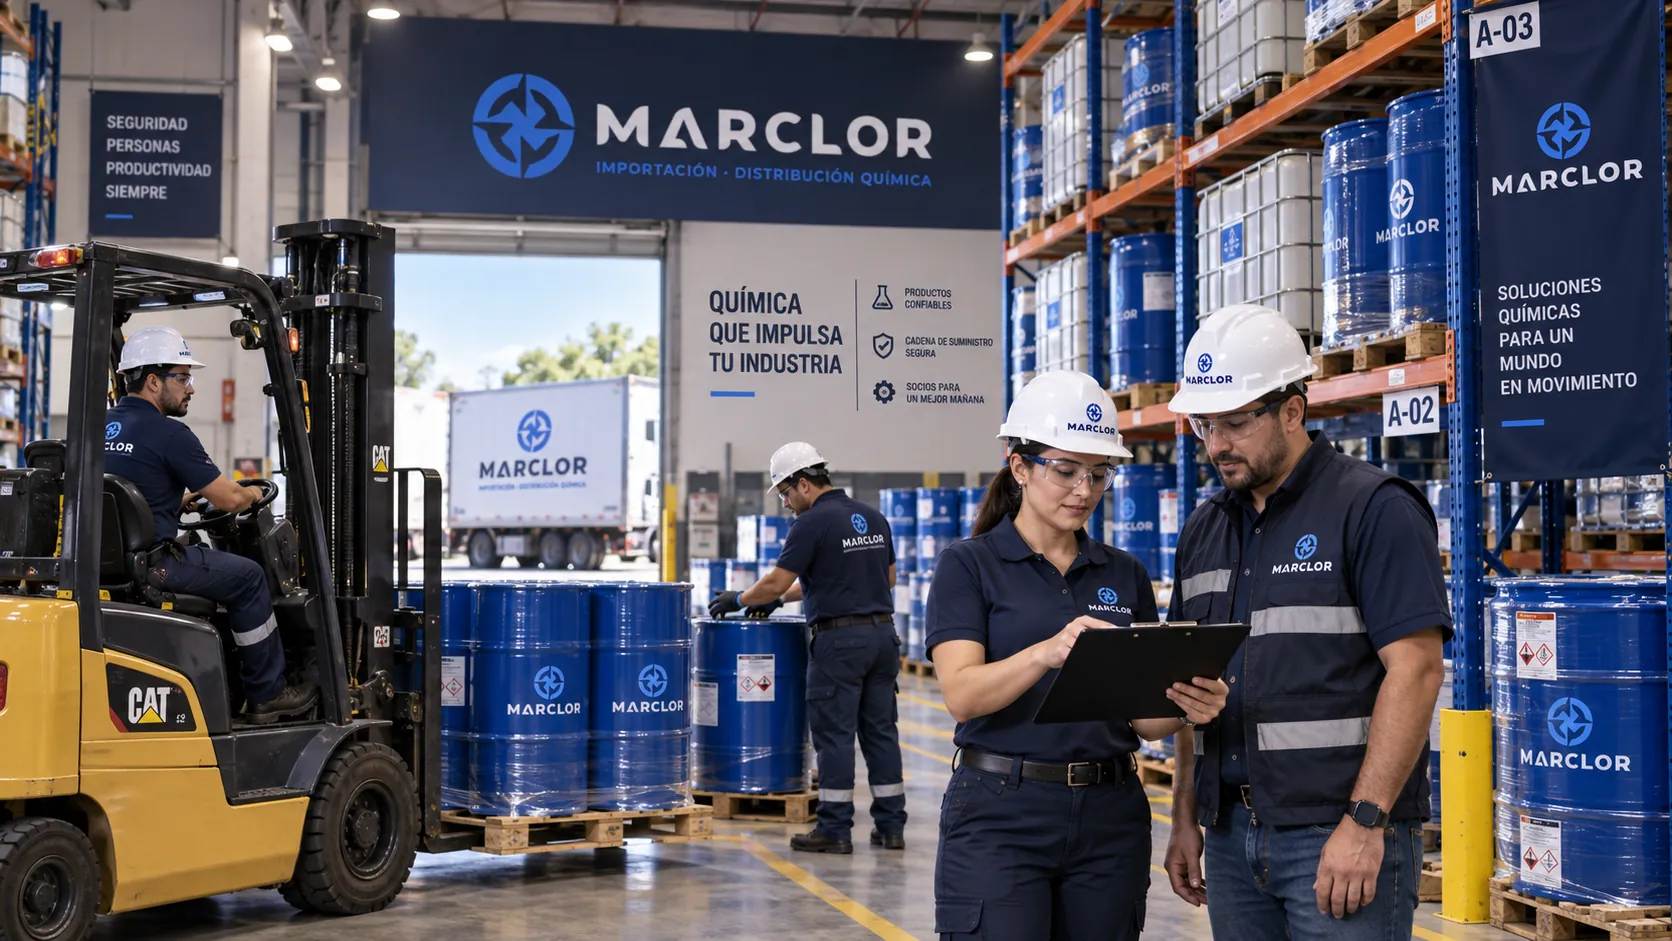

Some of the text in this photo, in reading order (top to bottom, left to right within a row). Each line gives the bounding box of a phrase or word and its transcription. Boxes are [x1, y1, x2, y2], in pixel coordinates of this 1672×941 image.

[1475, 12, 1534, 48] A-03
[107, 115, 188, 131] SEGURIDAD
[596, 103, 932, 159] MARCLOR
[106, 138, 181, 153] PERSONAS
[106, 161, 212, 177] PRODUCTIVIDAD
[596, 161, 717, 178] IMPORTACIÓN
[735, 167, 854, 184] DISTRIBUCIÓN
[860, 170, 932, 187] QUÍMICA
[1491, 158, 1643, 197] MARCLOR
[105, 184, 167, 199] SIEMPRE
[1375, 218, 1440, 244] MARCLOR
[904, 288, 952, 298] PRODUCTOS
[1498, 277, 1602, 301] SOLUCIONES
[709, 285, 802, 315] QUÍMICA
[904, 300, 952, 310] CONFIABLES
[1498, 303, 1581, 325] QUÍMICAS
[709, 322, 843, 345] QUE IMPULSA
[905, 336, 994, 347] CADENA DE SUMINISTRO
[1500, 327, 1574, 348] PARA UN
[905, 348, 936, 358] SEGURA
[1500, 353, 1562, 371] MUNDO
[709, 352, 843, 374] TU INDUSTRIA
[906, 382, 960, 392] SOCIOS PARA
[1185, 375, 1233, 385] MARCLOR
[1501, 371, 1638, 396] EN MOVIMIENTO
[906, 394, 985, 404] UN MEJOR MAÑANA
[1388, 395, 1435, 427] A-02
[1067, 422, 1116, 436] MARCLOR
[104, 442, 134, 453] CLOR
[372, 445, 390, 470] CAT
[479, 456, 588, 479] MARCLOR
[842, 534, 885, 548] MARCLOR
[1271, 561, 1332, 575] MARCLOR
[128, 686, 171, 724] CAT
[507, 702, 581, 716] MARCLOR
[611, 700, 684, 714] MARCLOR
[1520, 748, 1631, 772] MARCLOR
